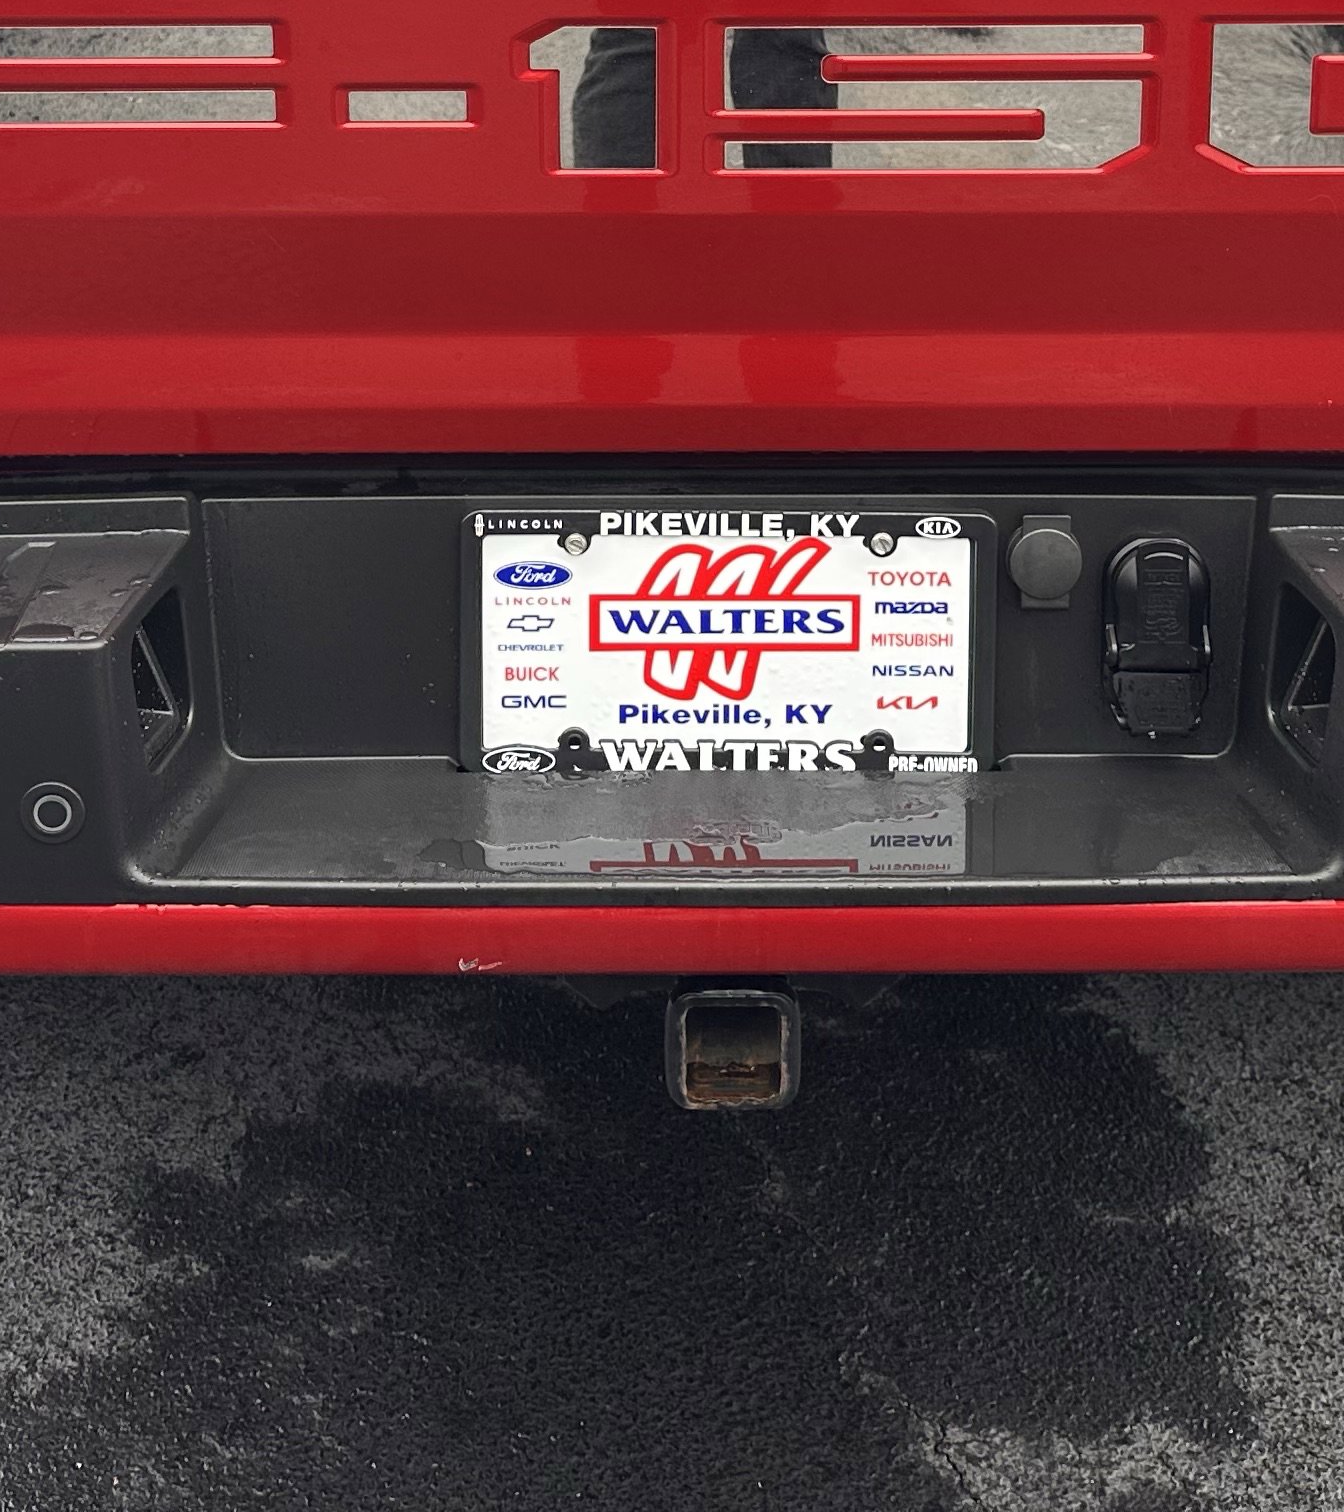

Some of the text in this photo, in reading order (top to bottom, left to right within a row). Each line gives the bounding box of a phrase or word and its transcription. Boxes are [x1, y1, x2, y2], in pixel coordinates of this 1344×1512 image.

[487, 518, 564, 530] LINCOLN
[599, 511, 861, 542] PIKEVILLE, KY
[510, 563, 558, 584] Ford
[867, 570, 953, 587] TOYOTA
[494, 596, 572, 606] LINCOLN
[607, 608, 846, 636] WALTERS
[497, 643, 565, 652] CHEVROLET
[870, 632, 954, 648] MITSUBISHI
[504, 666, 560, 682] BUICK
[871, 664, 955, 678] NISSAN
[500, 694, 568, 709] GMC
[876, 695, 939, 710] KIA
[618, 703, 833, 729] Pikeville, KY
[600, 740, 857, 772] WALTERS
[888, 754, 979, 773] PRE-OWNED
